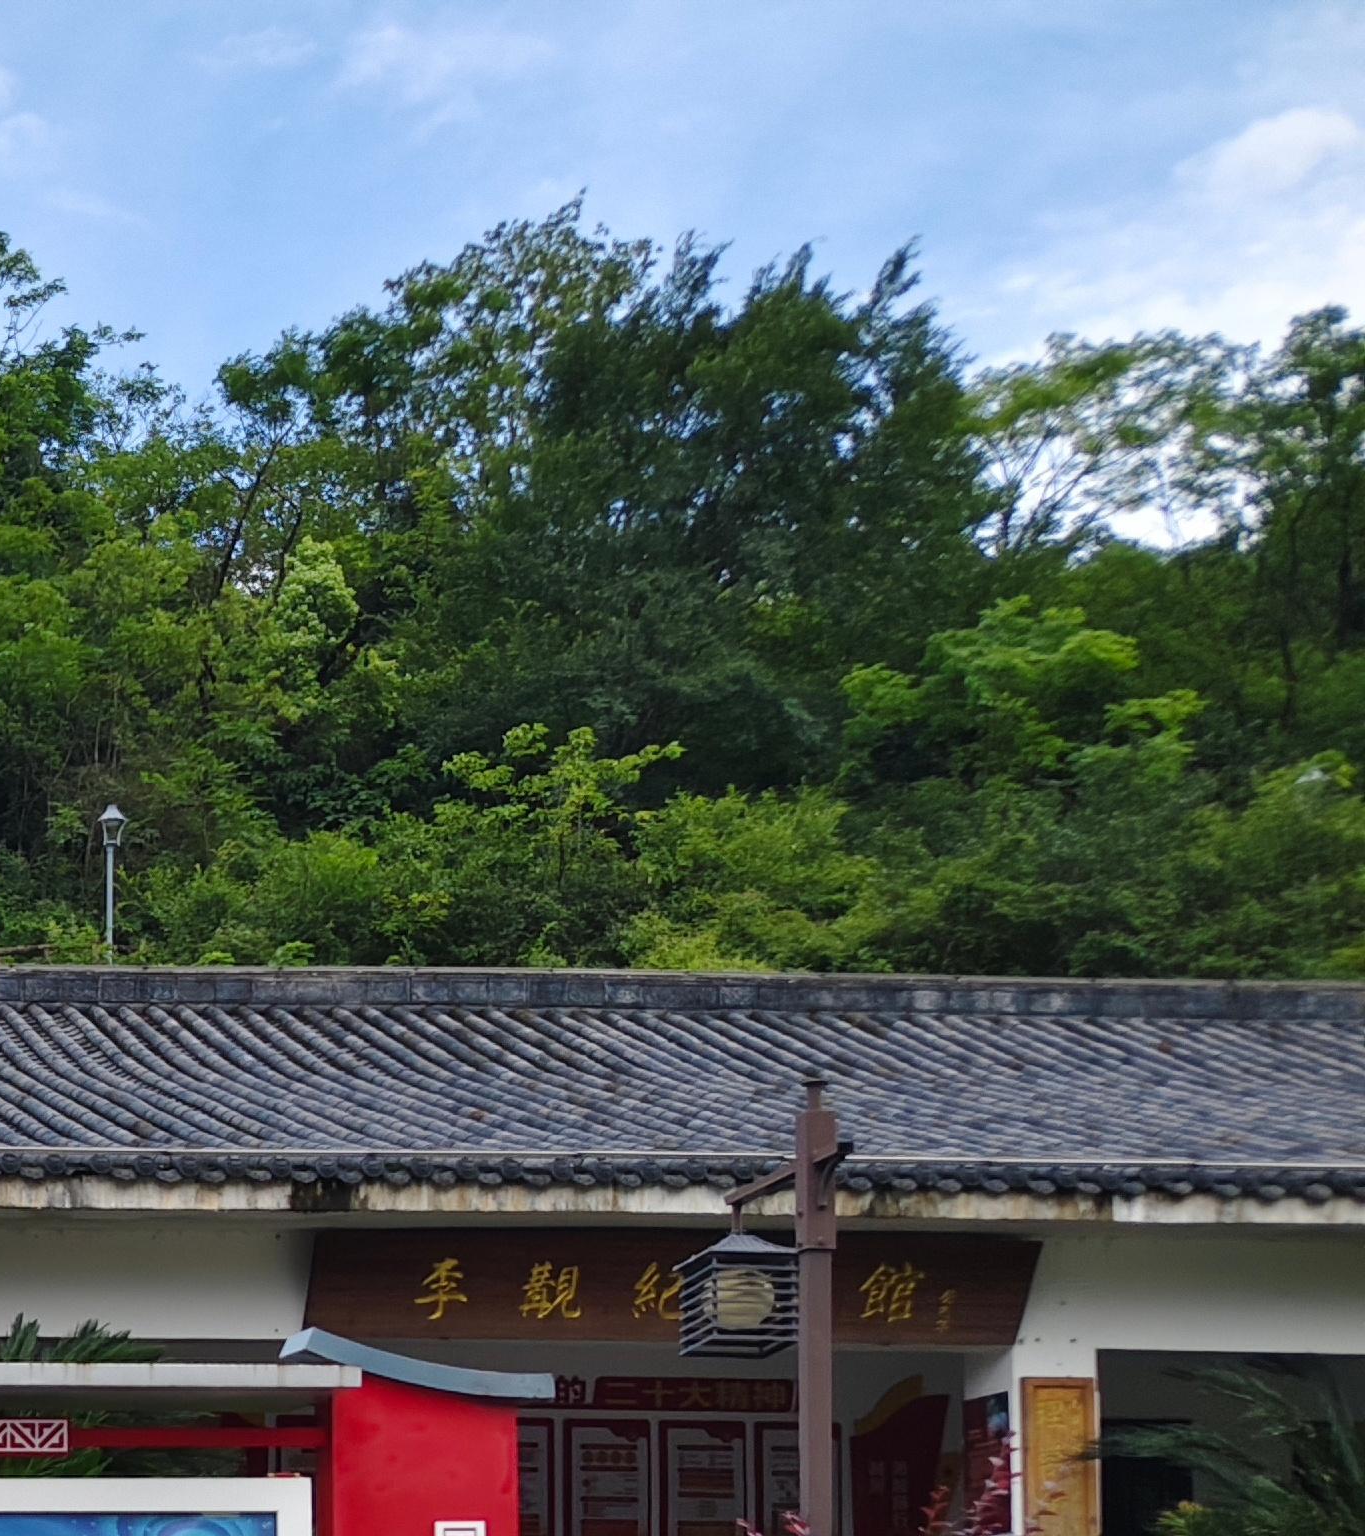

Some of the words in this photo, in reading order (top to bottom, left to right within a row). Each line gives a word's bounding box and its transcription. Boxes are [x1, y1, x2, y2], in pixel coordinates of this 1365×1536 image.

[413, 1258, 925, 1322] 李覯紀館
[604, 1380, 787, 1410] 二十大精神
